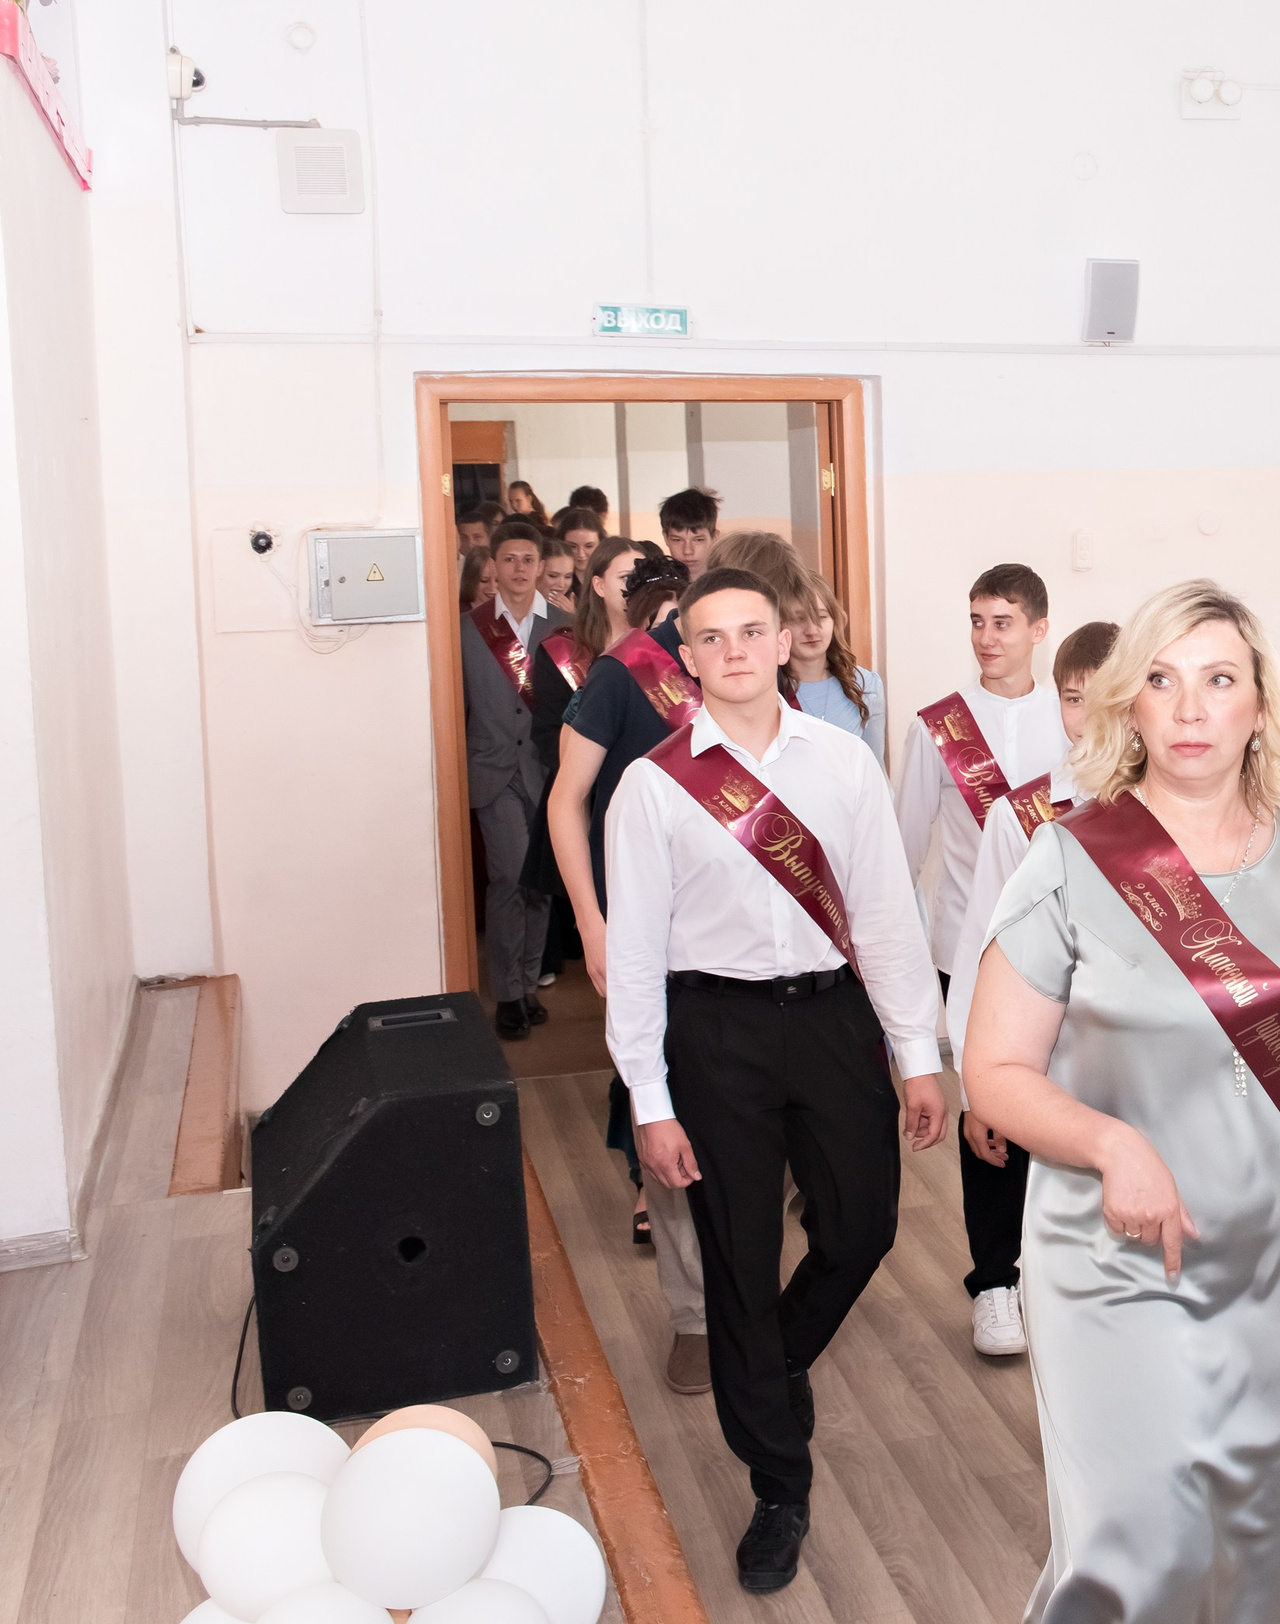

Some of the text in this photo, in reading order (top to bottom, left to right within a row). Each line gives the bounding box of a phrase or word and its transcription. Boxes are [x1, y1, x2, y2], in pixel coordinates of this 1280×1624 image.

[603, 310, 682, 331] ВЫХОД
[719, 800, 739, 818] класс
[751, 812, 844, 932] Выпускник
[1134, 882, 1168, 918] 9 класс
[1180, 918, 1271, 1008] Классный
